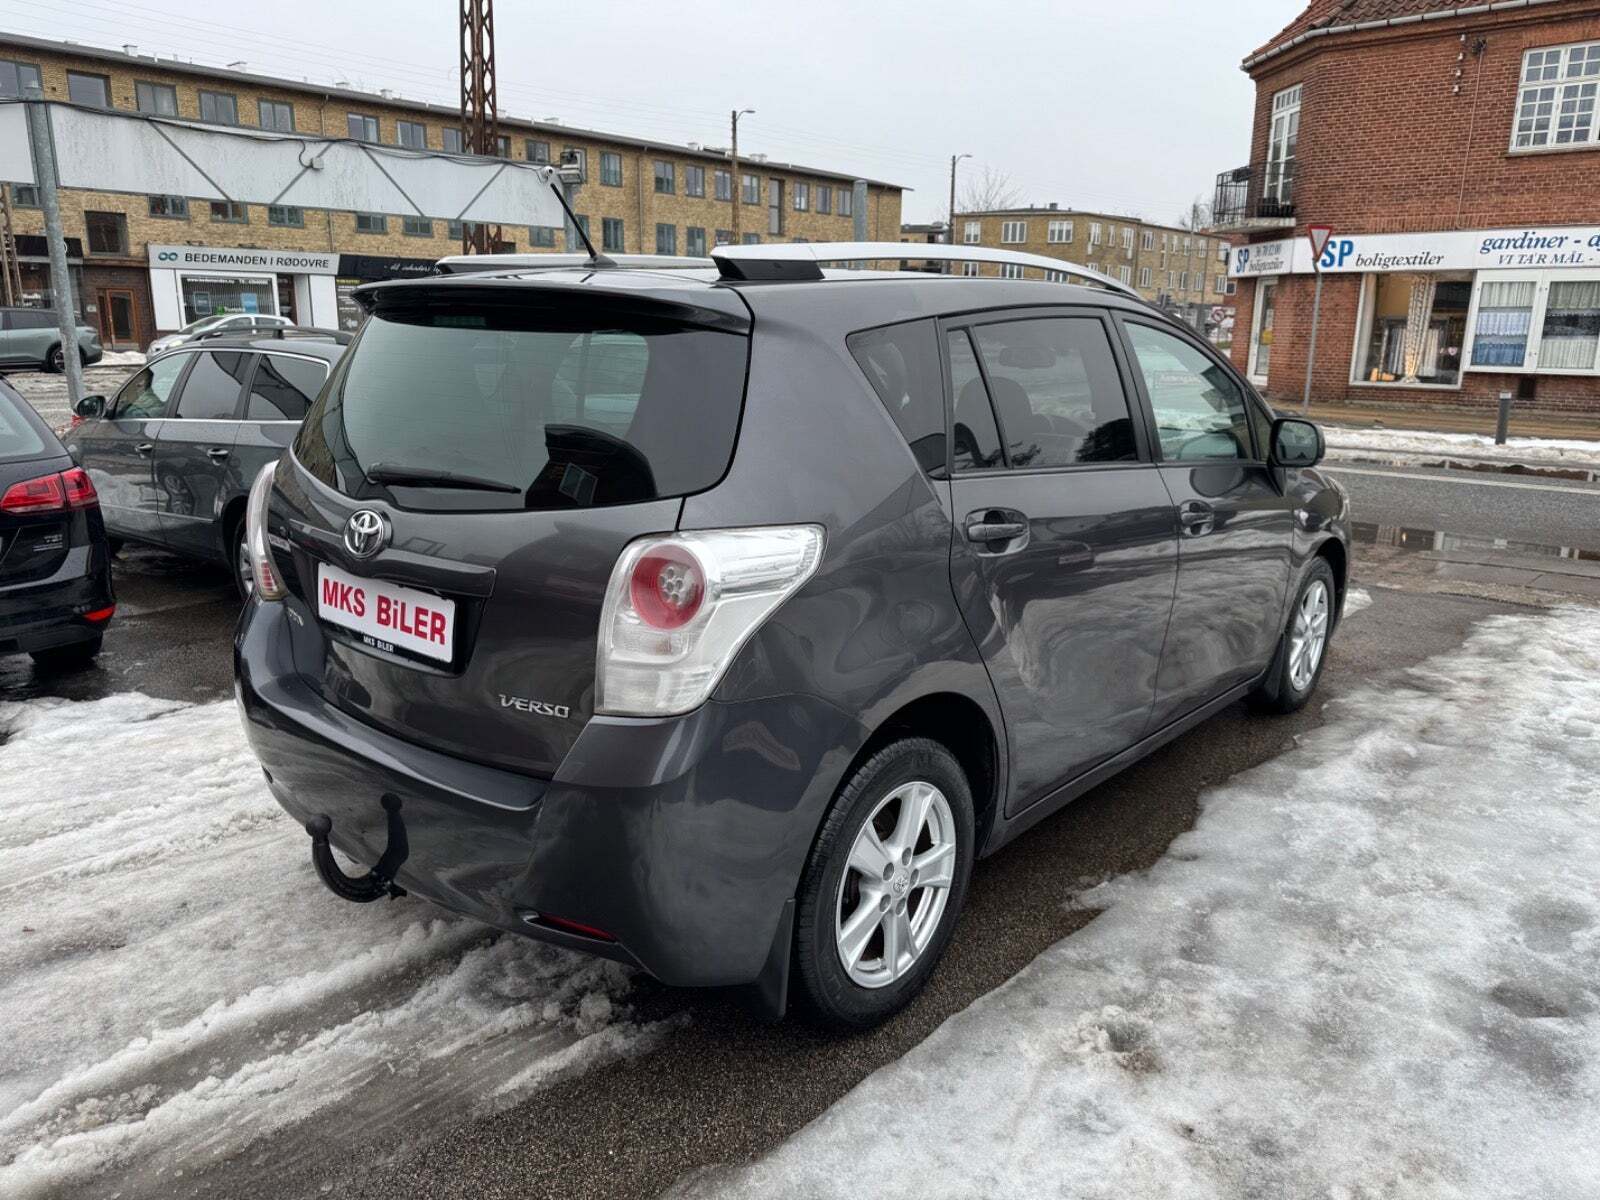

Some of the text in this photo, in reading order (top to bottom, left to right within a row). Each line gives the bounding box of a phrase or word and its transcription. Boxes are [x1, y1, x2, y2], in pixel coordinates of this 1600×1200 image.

[1321, 240, 1354, 268] SP
[1480, 231, 1569, 254] gardiner
[185, 252, 329, 268] BEDEMANDEN I RØDOVRE
[1236, 248, 1249, 273] SP
[1356, 251, 1444, 269] boligtextiler
[1499, 254, 1515, 264] VI
[1550, 251, 1584, 264] MÅL
[323, 578, 365, 617] MKS
[377, 594, 446, 645] BiLER
[363, 636, 375, 646] MKS
[499, 694, 569, 718] VERSO
